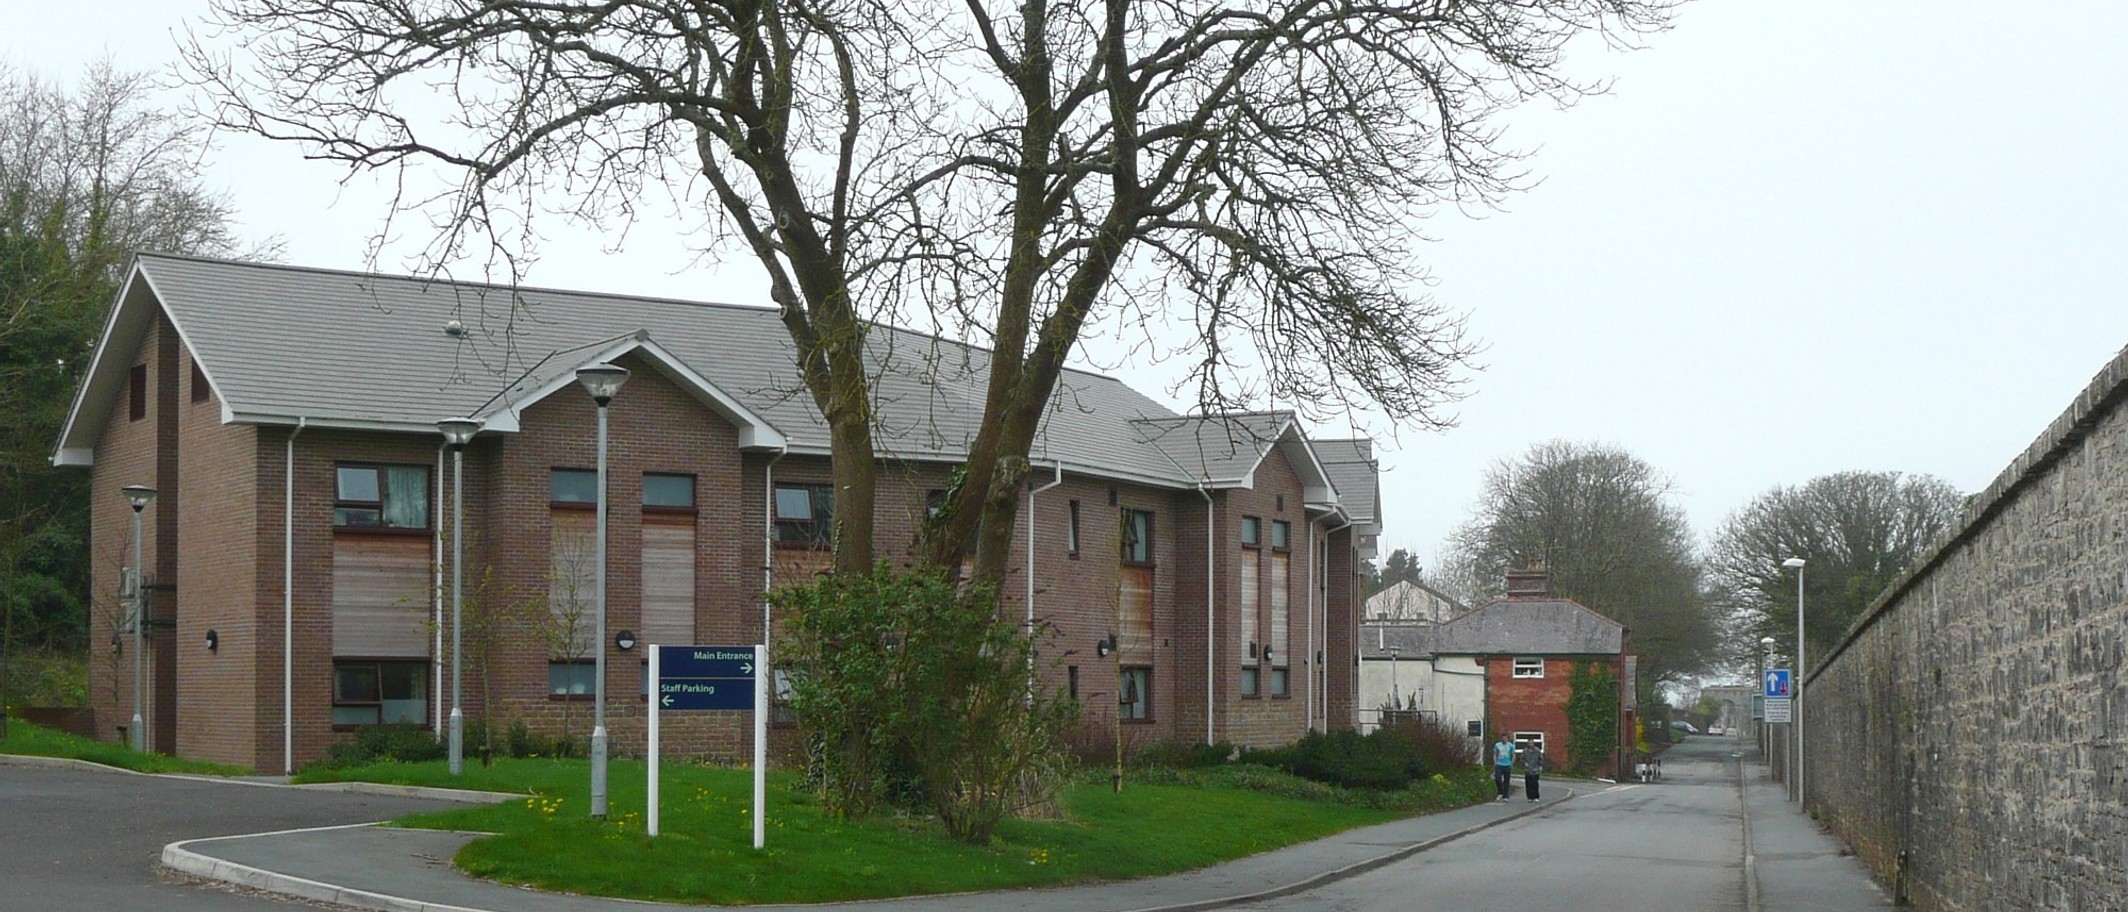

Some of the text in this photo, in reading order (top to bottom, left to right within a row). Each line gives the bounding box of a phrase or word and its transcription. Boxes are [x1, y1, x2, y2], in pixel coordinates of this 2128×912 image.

[693, 651, 754, 660] Main Entrance
[661, 684, 715, 695] Staff Parking
